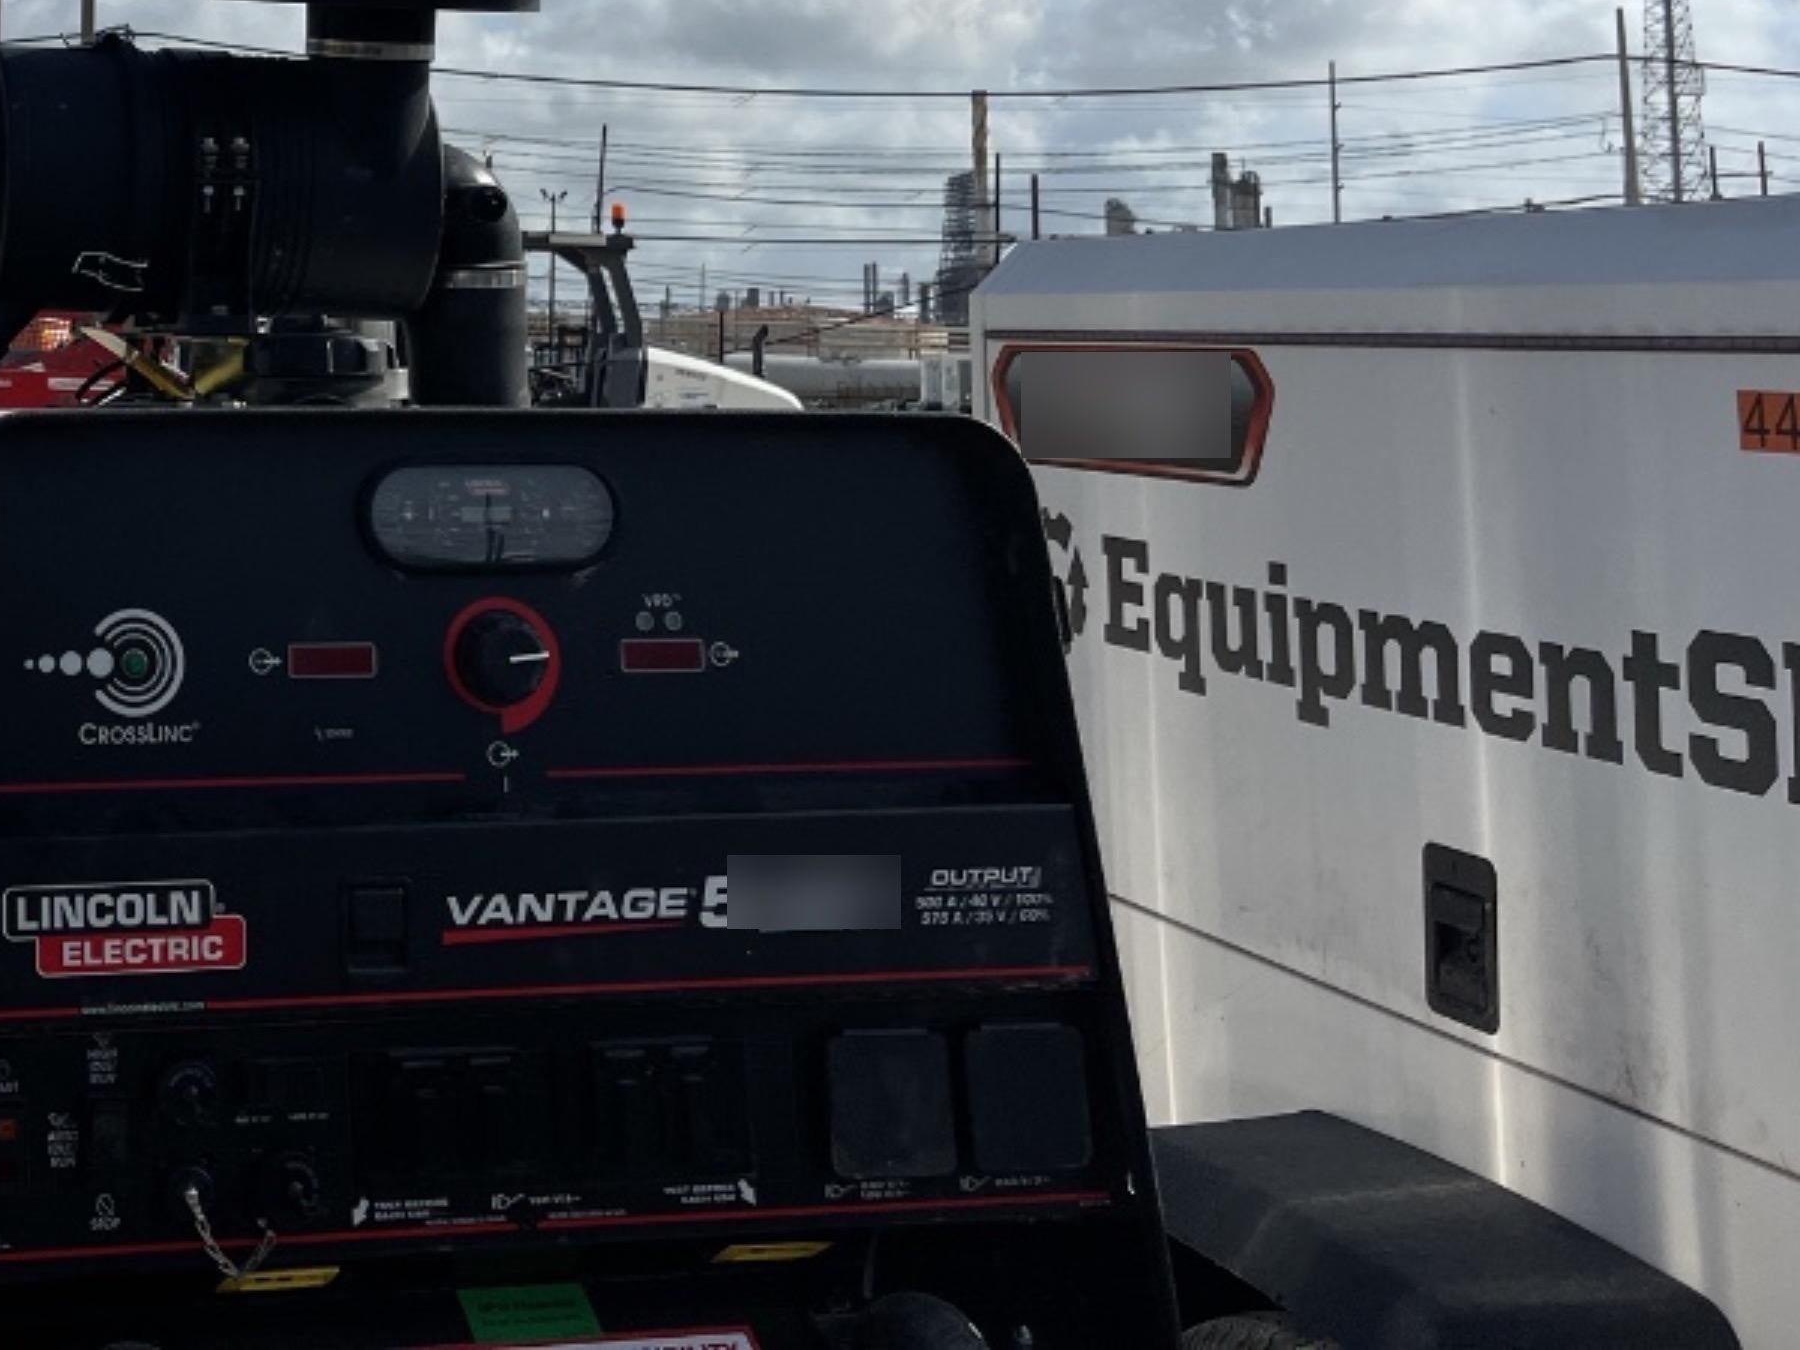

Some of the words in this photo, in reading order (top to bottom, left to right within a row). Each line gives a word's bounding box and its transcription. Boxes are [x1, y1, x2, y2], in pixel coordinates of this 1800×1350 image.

[1101, 533, 1800, 806] EquipmentS
[930, 865, 1034, 889] OUTPUT
[15, 889, 201, 932] LINCOLN
[445, 885, 691, 927] VANTAGE
[61, 934, 225, 968] ELECTRIC
